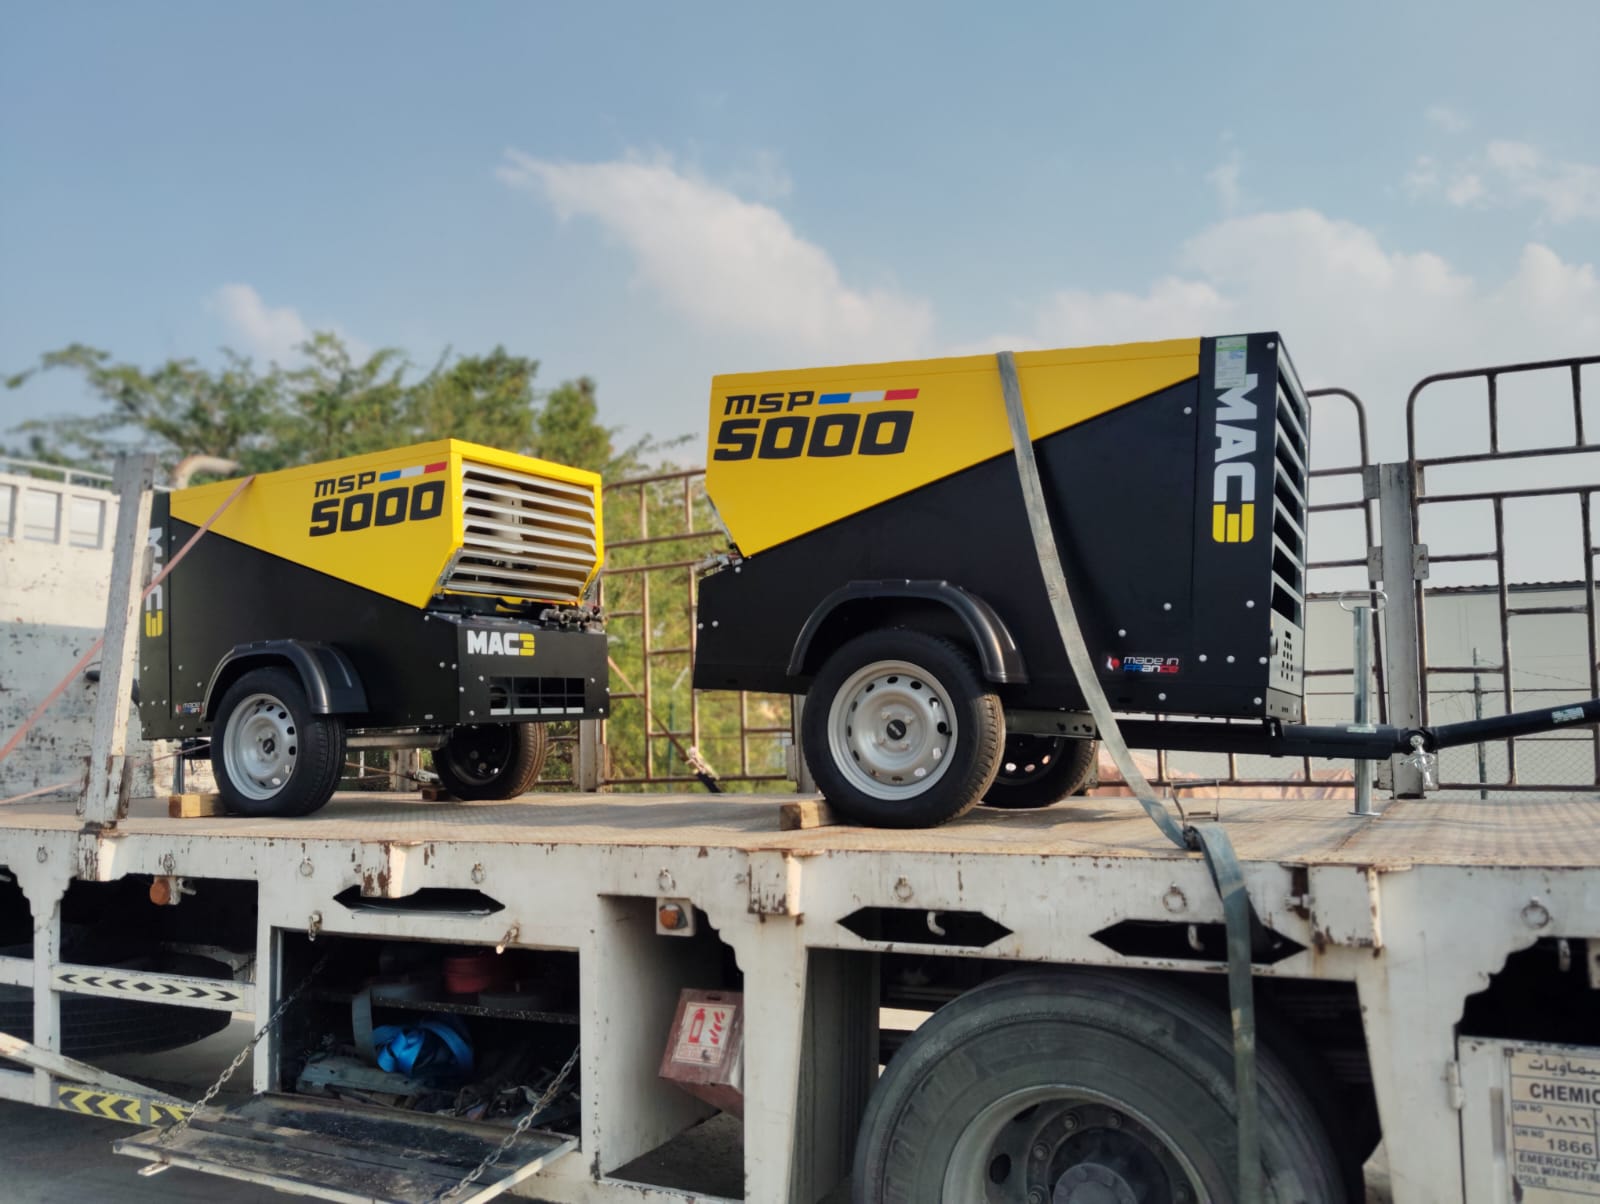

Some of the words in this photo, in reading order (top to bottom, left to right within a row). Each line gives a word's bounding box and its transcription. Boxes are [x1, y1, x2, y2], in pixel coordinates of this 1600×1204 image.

[713, 410, 915, 461] 5000
[309, 480, 446, 537] 5000
[466, 629, 536, 657] MAC3
[1546, 1137, 1593, 1156] 1866
[1518, 1152, 1598, 1172] EMERGENCY
